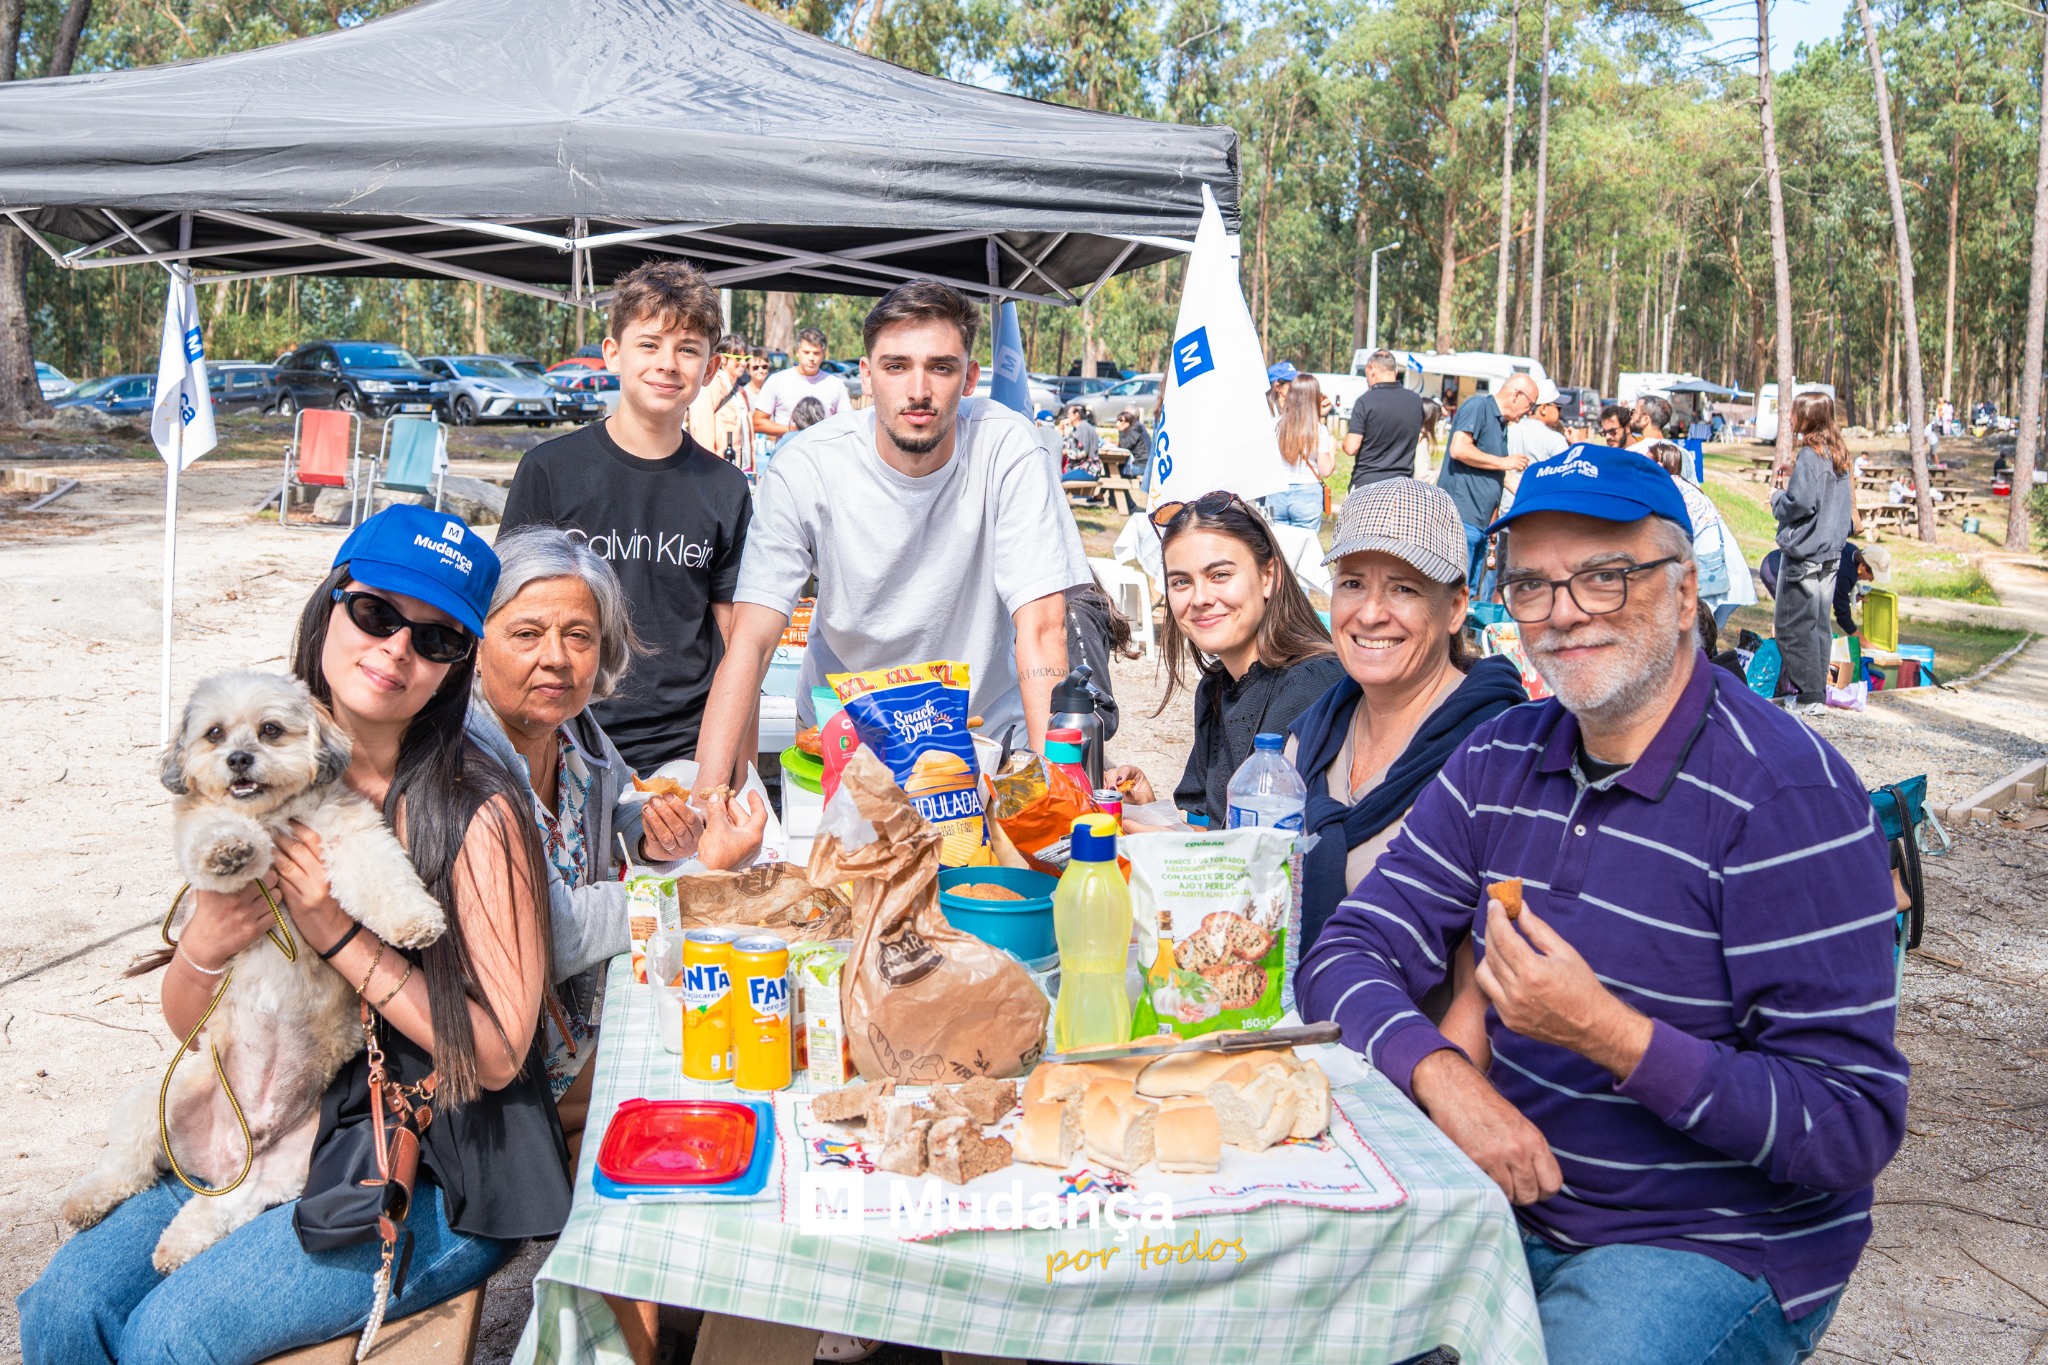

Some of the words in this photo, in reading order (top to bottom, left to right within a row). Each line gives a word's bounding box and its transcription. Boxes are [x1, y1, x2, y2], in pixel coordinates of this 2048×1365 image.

[1179, 340, 1203, 373] M
[413, 533, 473, 572] Mudança
[884, 666, 924, 685] XXL
[893, 699, 938, 730] Snack
[901, 717, 954, 744] Day
[1214, 872, 1225, 880] DE
